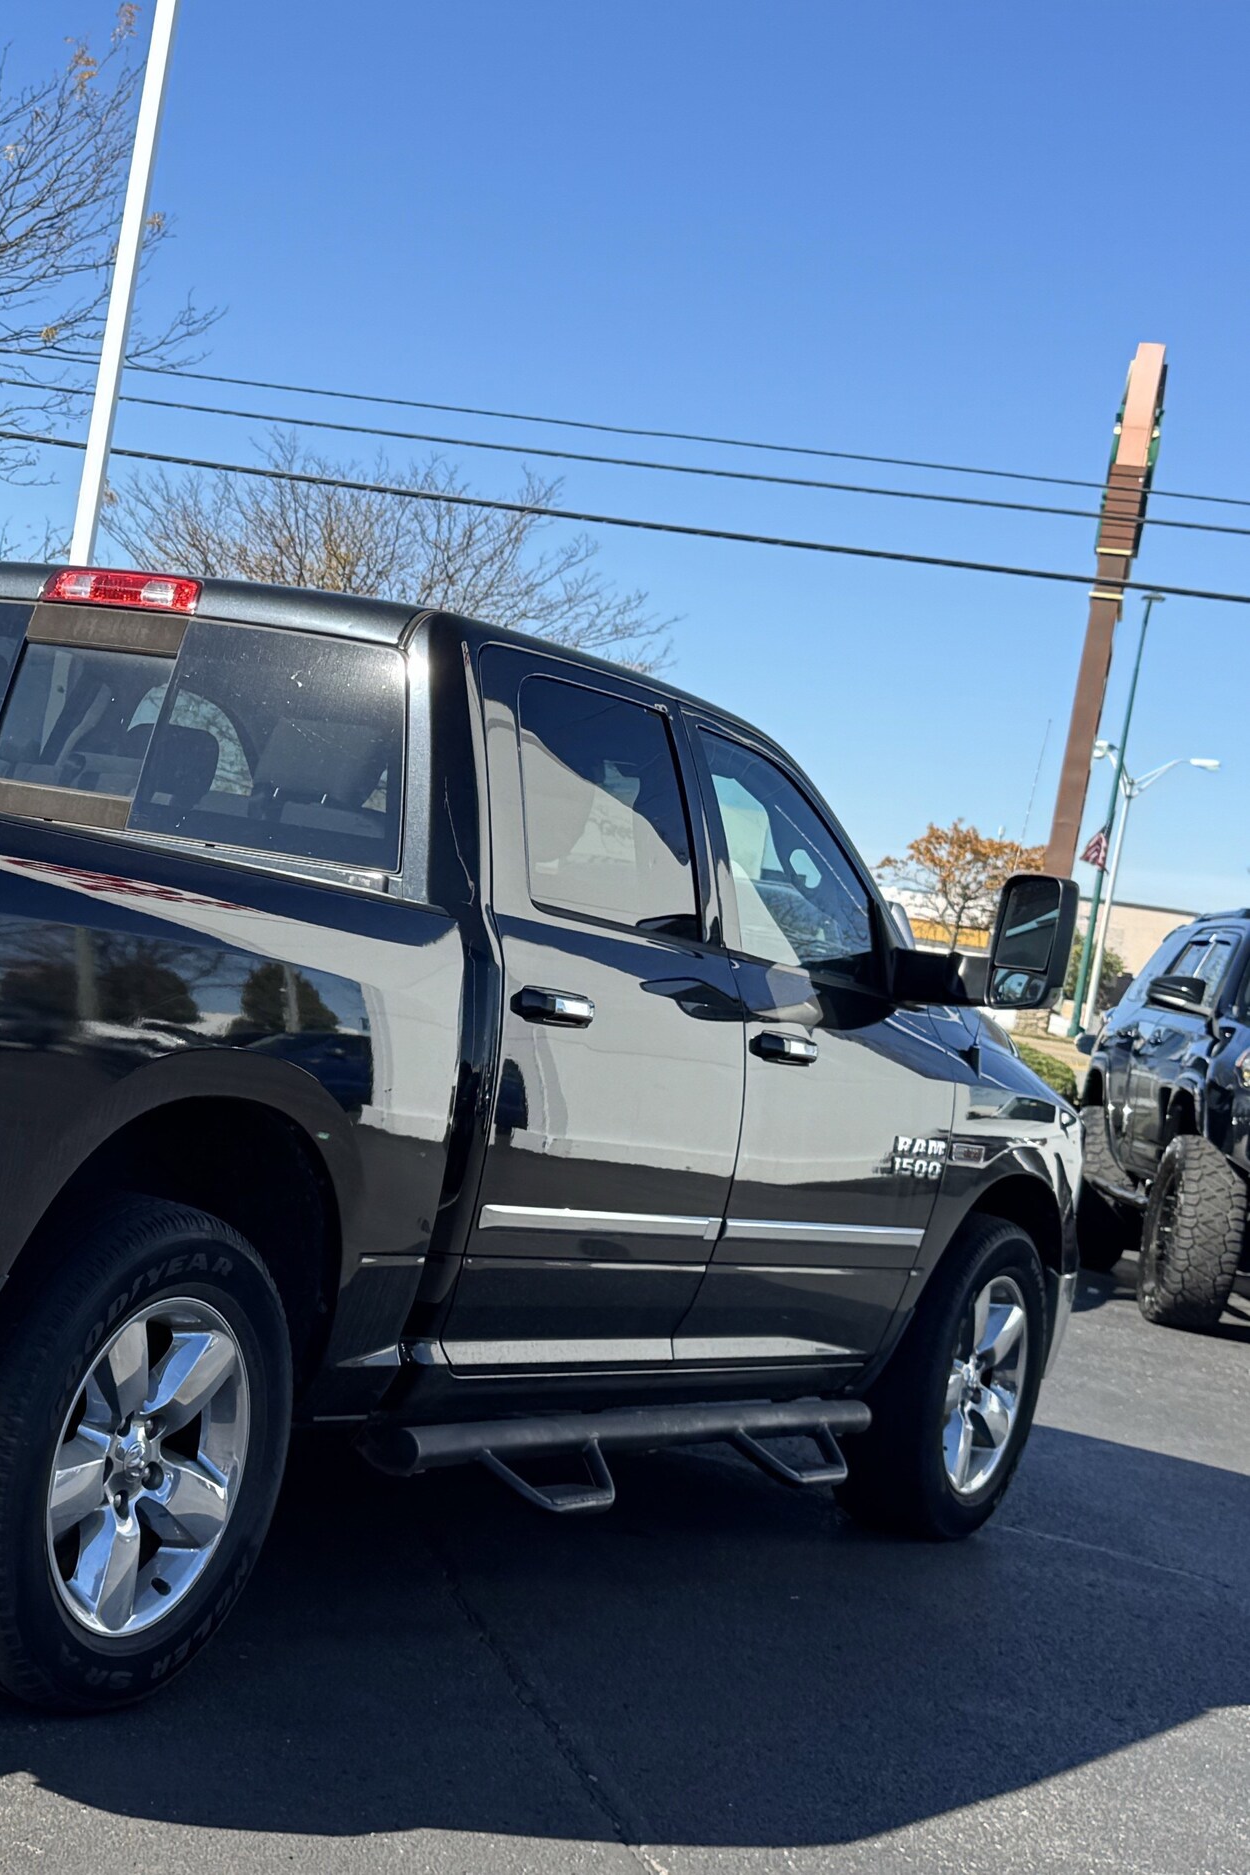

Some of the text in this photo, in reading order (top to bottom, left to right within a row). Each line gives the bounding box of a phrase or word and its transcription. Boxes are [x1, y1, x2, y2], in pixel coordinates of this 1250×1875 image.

[895, 1136, 946, 1156] RAM
[894, 1157, 942, 1180] 1500
[50, 1252, 234, 1431] GOODYEAR
